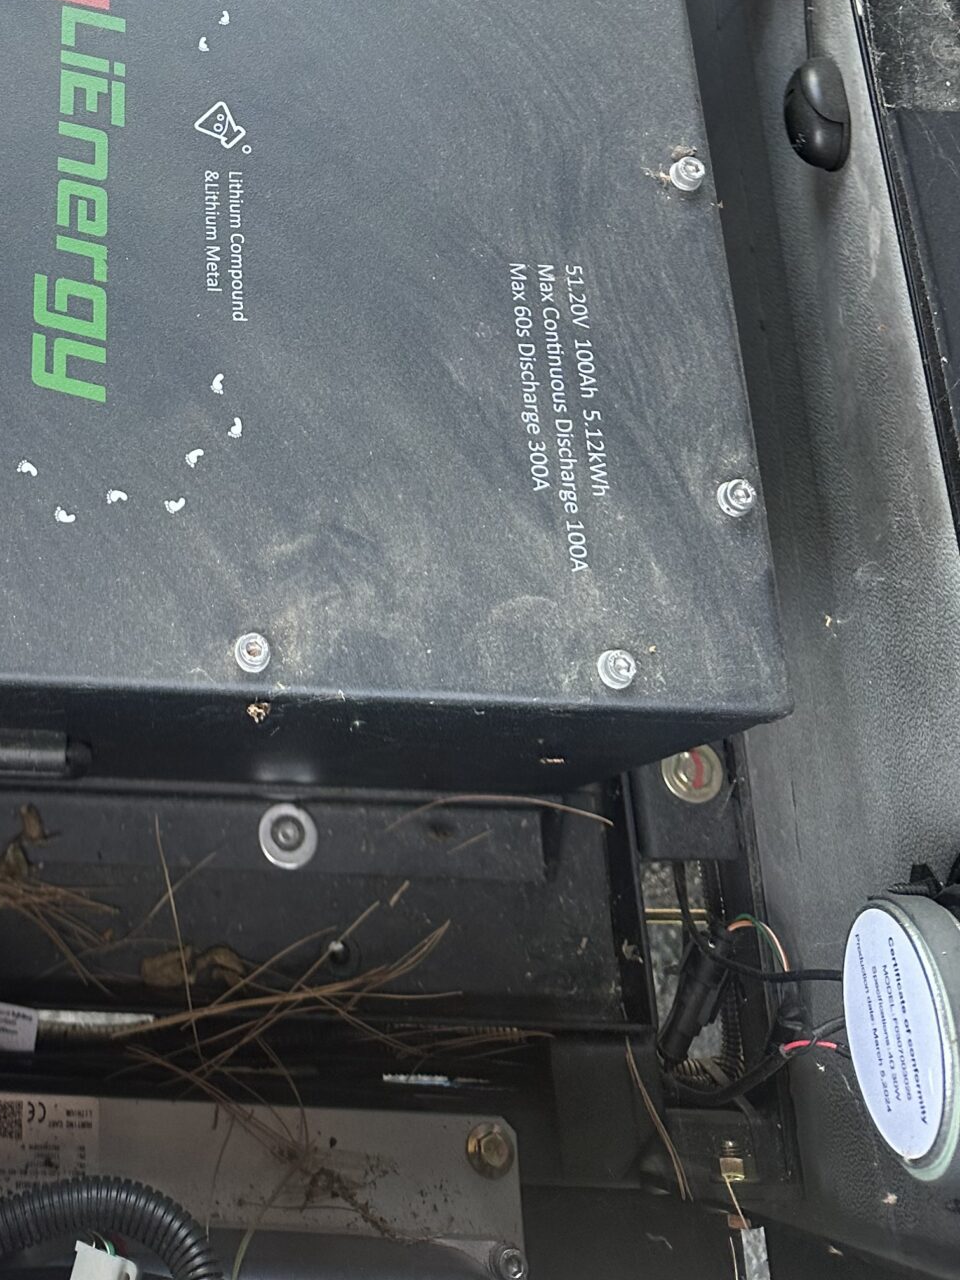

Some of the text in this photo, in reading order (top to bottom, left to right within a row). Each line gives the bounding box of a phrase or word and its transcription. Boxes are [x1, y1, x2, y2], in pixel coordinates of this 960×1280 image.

[203, 170, 223, 292] &Lithium Metal
[225, 170, 248, 321] Lithium Compound
[509, 263, 551, 491] Max 60s Discharge 300A
[537, 264, 589, 572] Max Continuous Discharge 100A
[565, 265, 610, 496] 51.20V 100Ah 5.12kWh
[855, 933, 869, 991] Production
[872, 1028, 883, 1067] March
[888, 937, 928, 1125] Certificate of conformity
